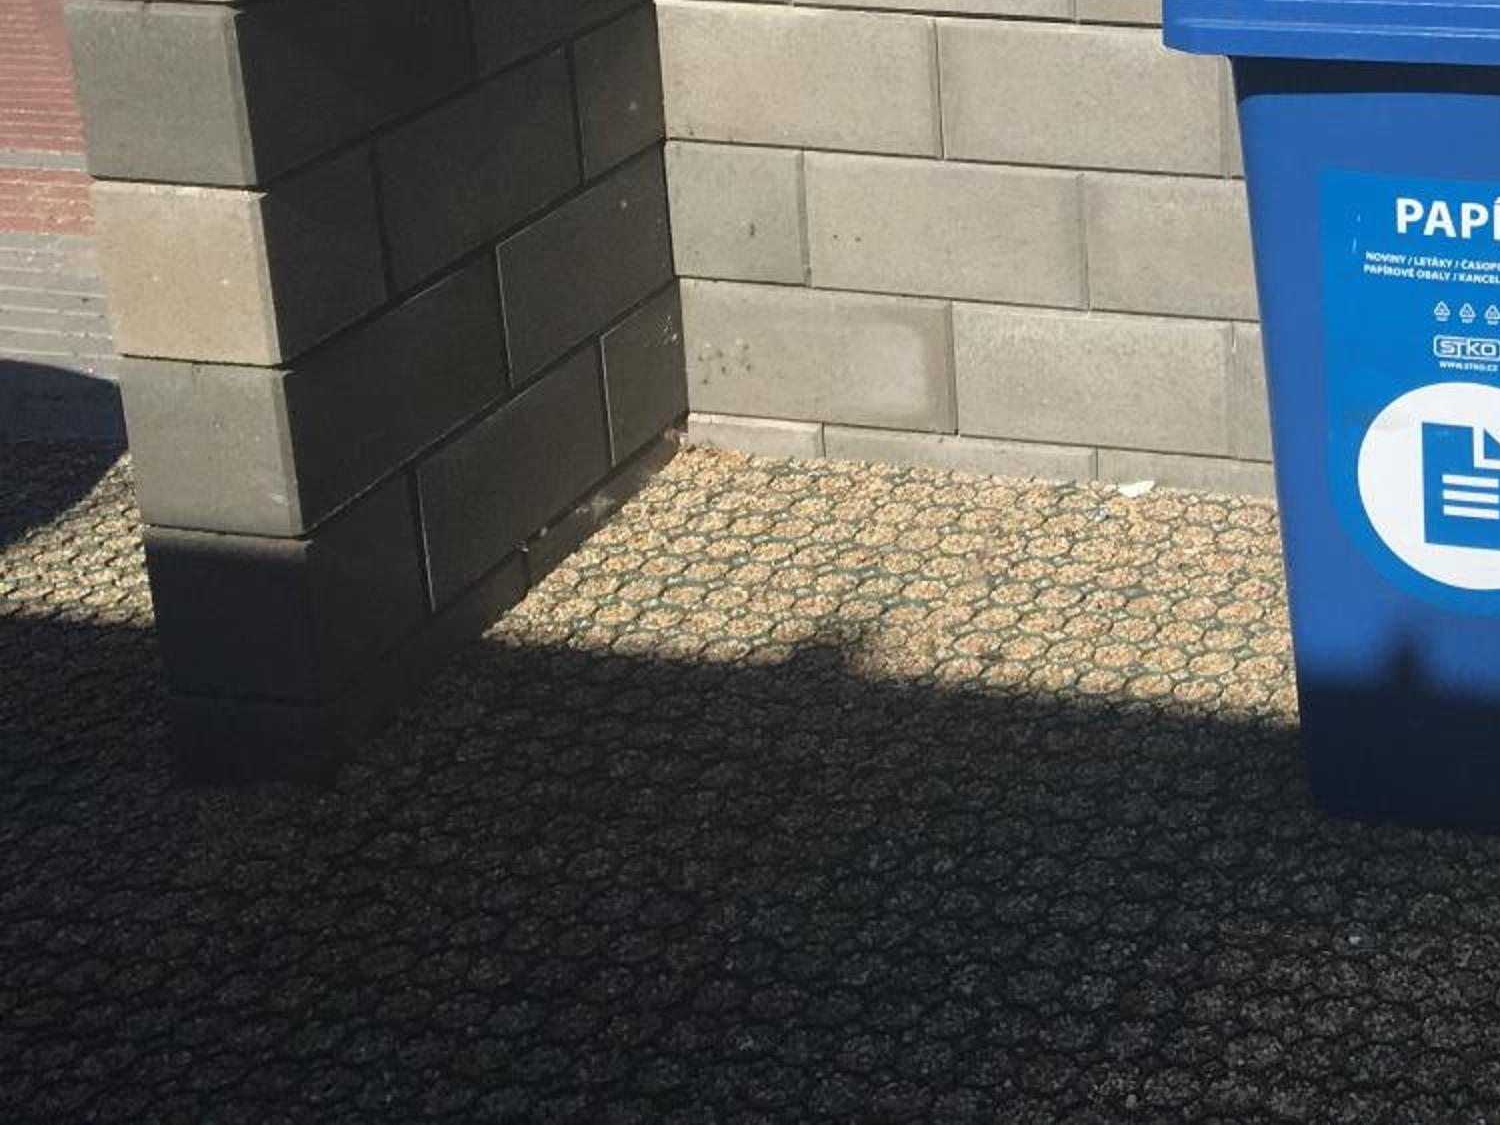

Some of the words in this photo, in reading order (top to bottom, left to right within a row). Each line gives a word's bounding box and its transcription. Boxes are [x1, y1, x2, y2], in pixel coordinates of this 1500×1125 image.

[1365, 251, 1407, 264] NOVINY
[1414, 255, 1453, 268] LETÁKY
[1363, 262, 1415, 279] PAPÍROVÉ
[1416, 268, 1451, 282] OBALY
[1438, 337, 1499, 359] STKO
